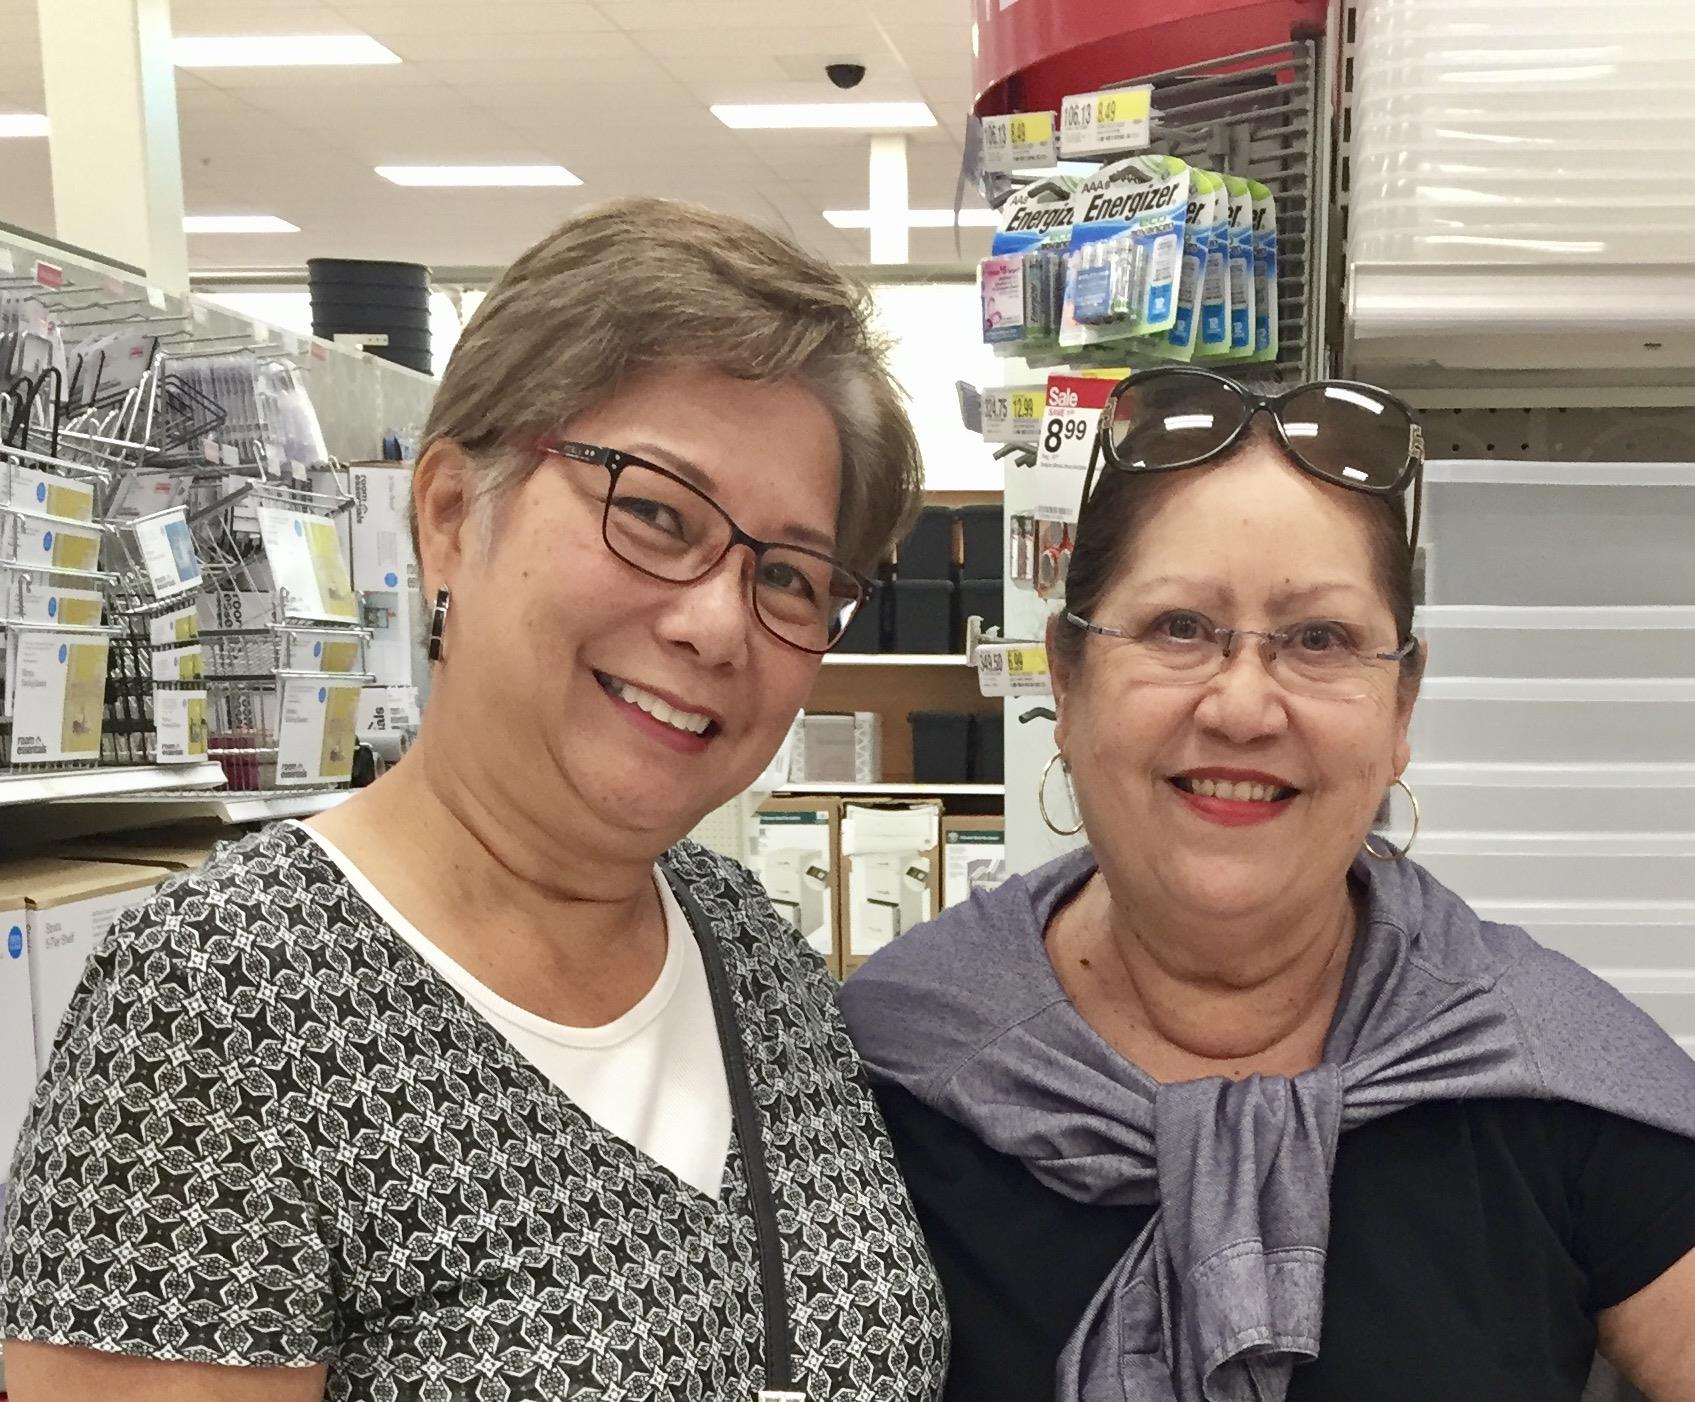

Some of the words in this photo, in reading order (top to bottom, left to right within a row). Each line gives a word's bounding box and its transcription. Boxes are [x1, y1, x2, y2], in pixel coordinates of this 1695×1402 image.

[1064, 103, 1091, 127] 106.13
[1097, 100, 1116, 123] 8.49
[1083, 182, 1181, 223] Energizer
[1005, 202, 1075, 235] Energiz
[1013, 398, 1033, 417] 12.99
[1049, 386, 1079, 407] Sale
